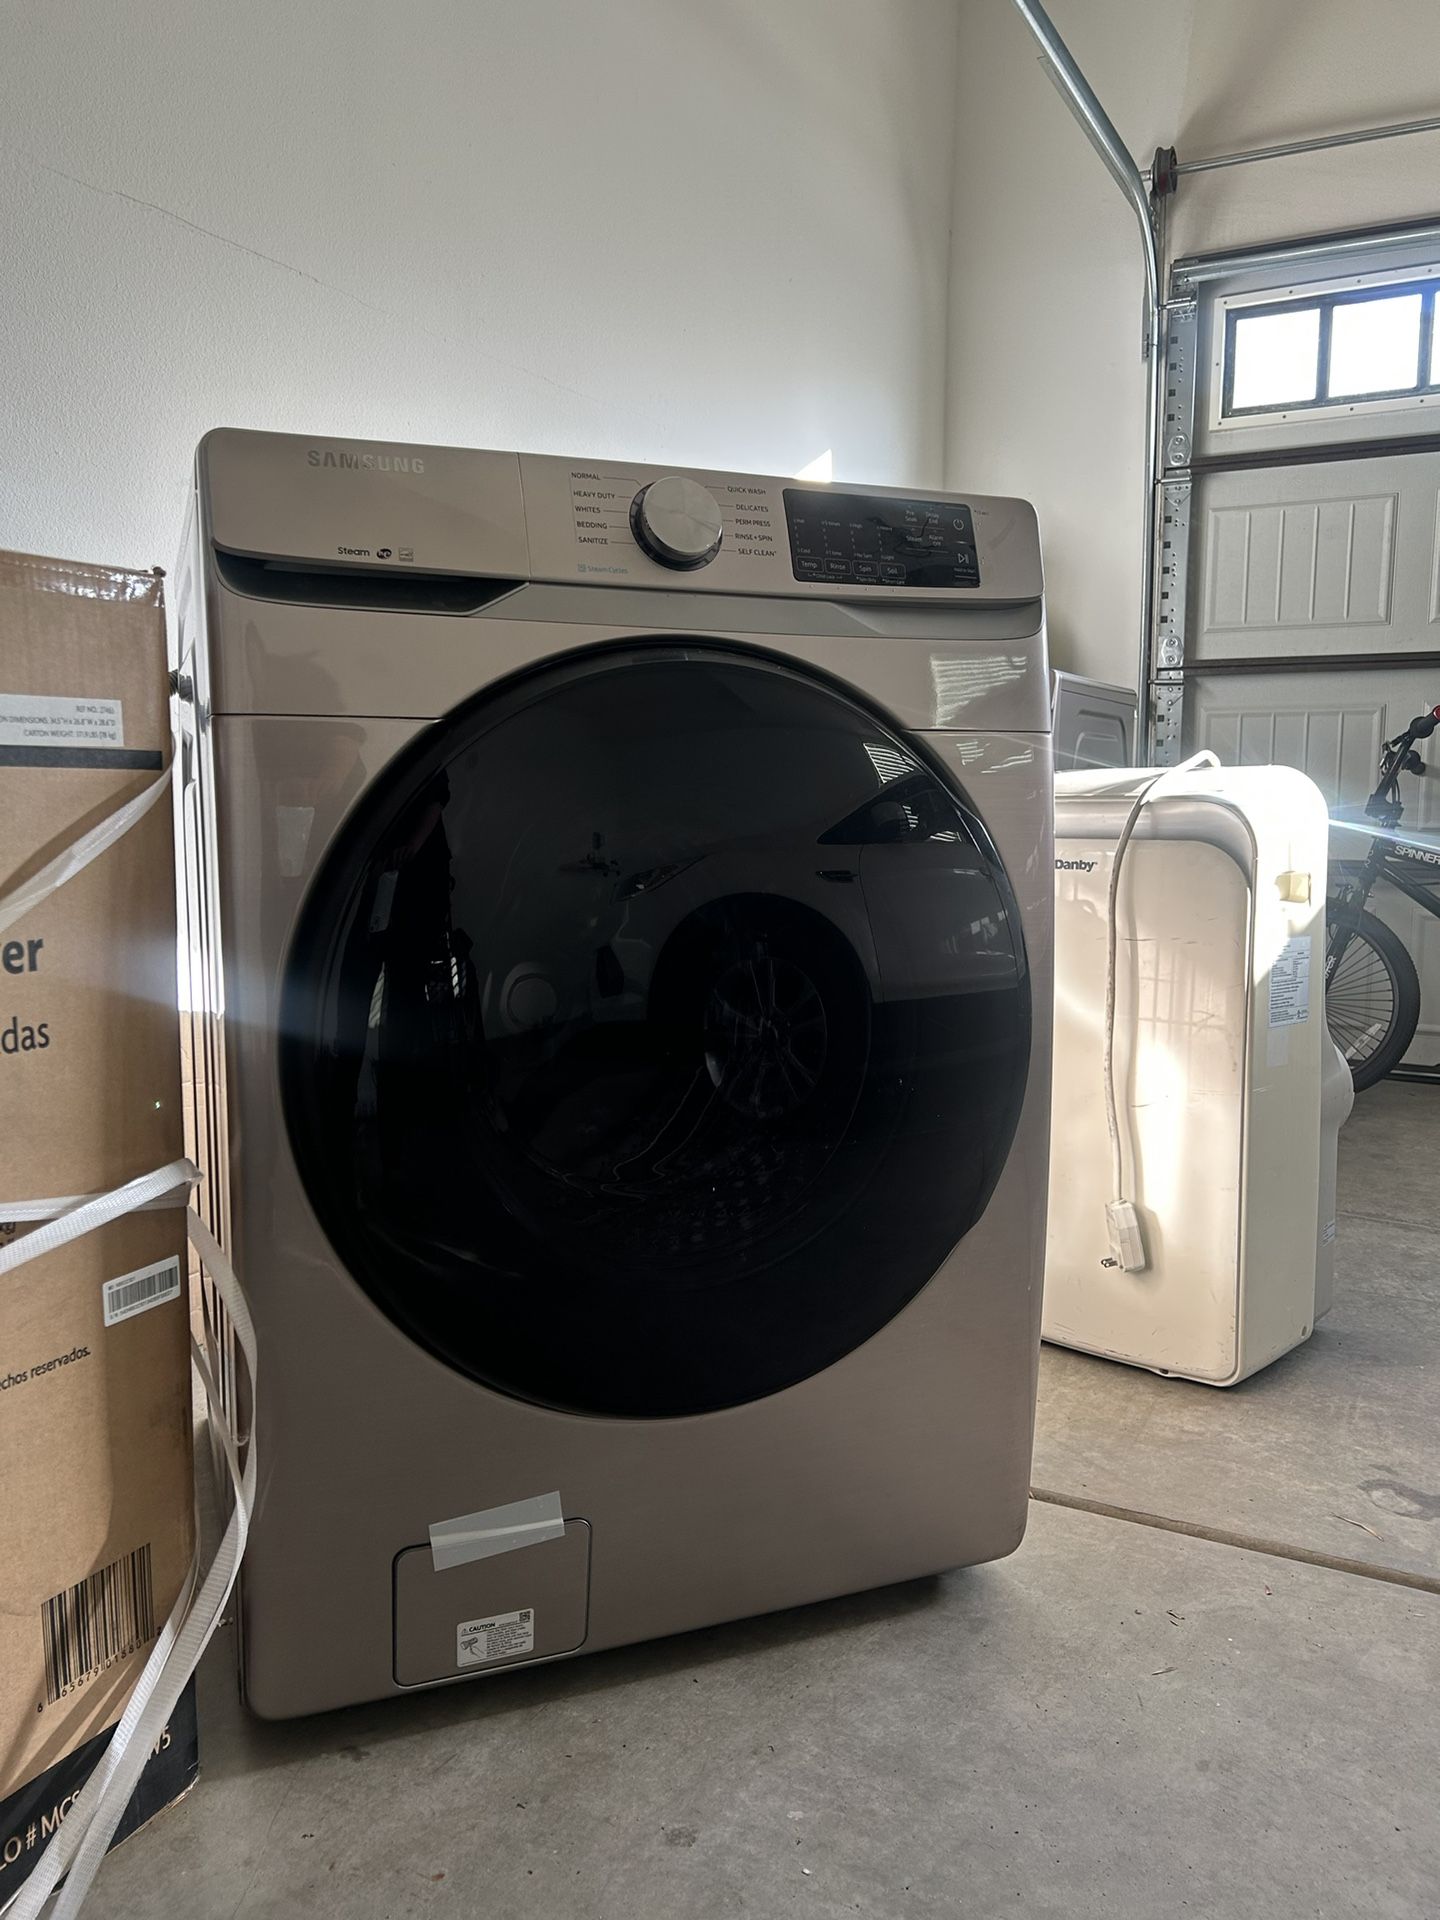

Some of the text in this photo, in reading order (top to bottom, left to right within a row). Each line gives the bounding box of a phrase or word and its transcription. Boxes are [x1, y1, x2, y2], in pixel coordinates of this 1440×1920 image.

[307, 450, 424, 473] SAMSUNG
[571, 472, 601, 480] NORMAL
[575, 505, 600, 513] WHITES
[736, 504, 768, 512] DELICATES
[577, 521, 607, 529] BEDDING
[578, 537, 608, 545] SANITIZE
[338, 546, 370, 556] Steam
[2, 938, 44, 974] er
[2, 1016, 50, 1054] das
[0, 1346, 91, 1392] chos reservados.
[469, 1623, 496, 1632] CAUTION
[37, 1702, 44, 1713] 6
[62, 1666, 99, 1697] 65679
